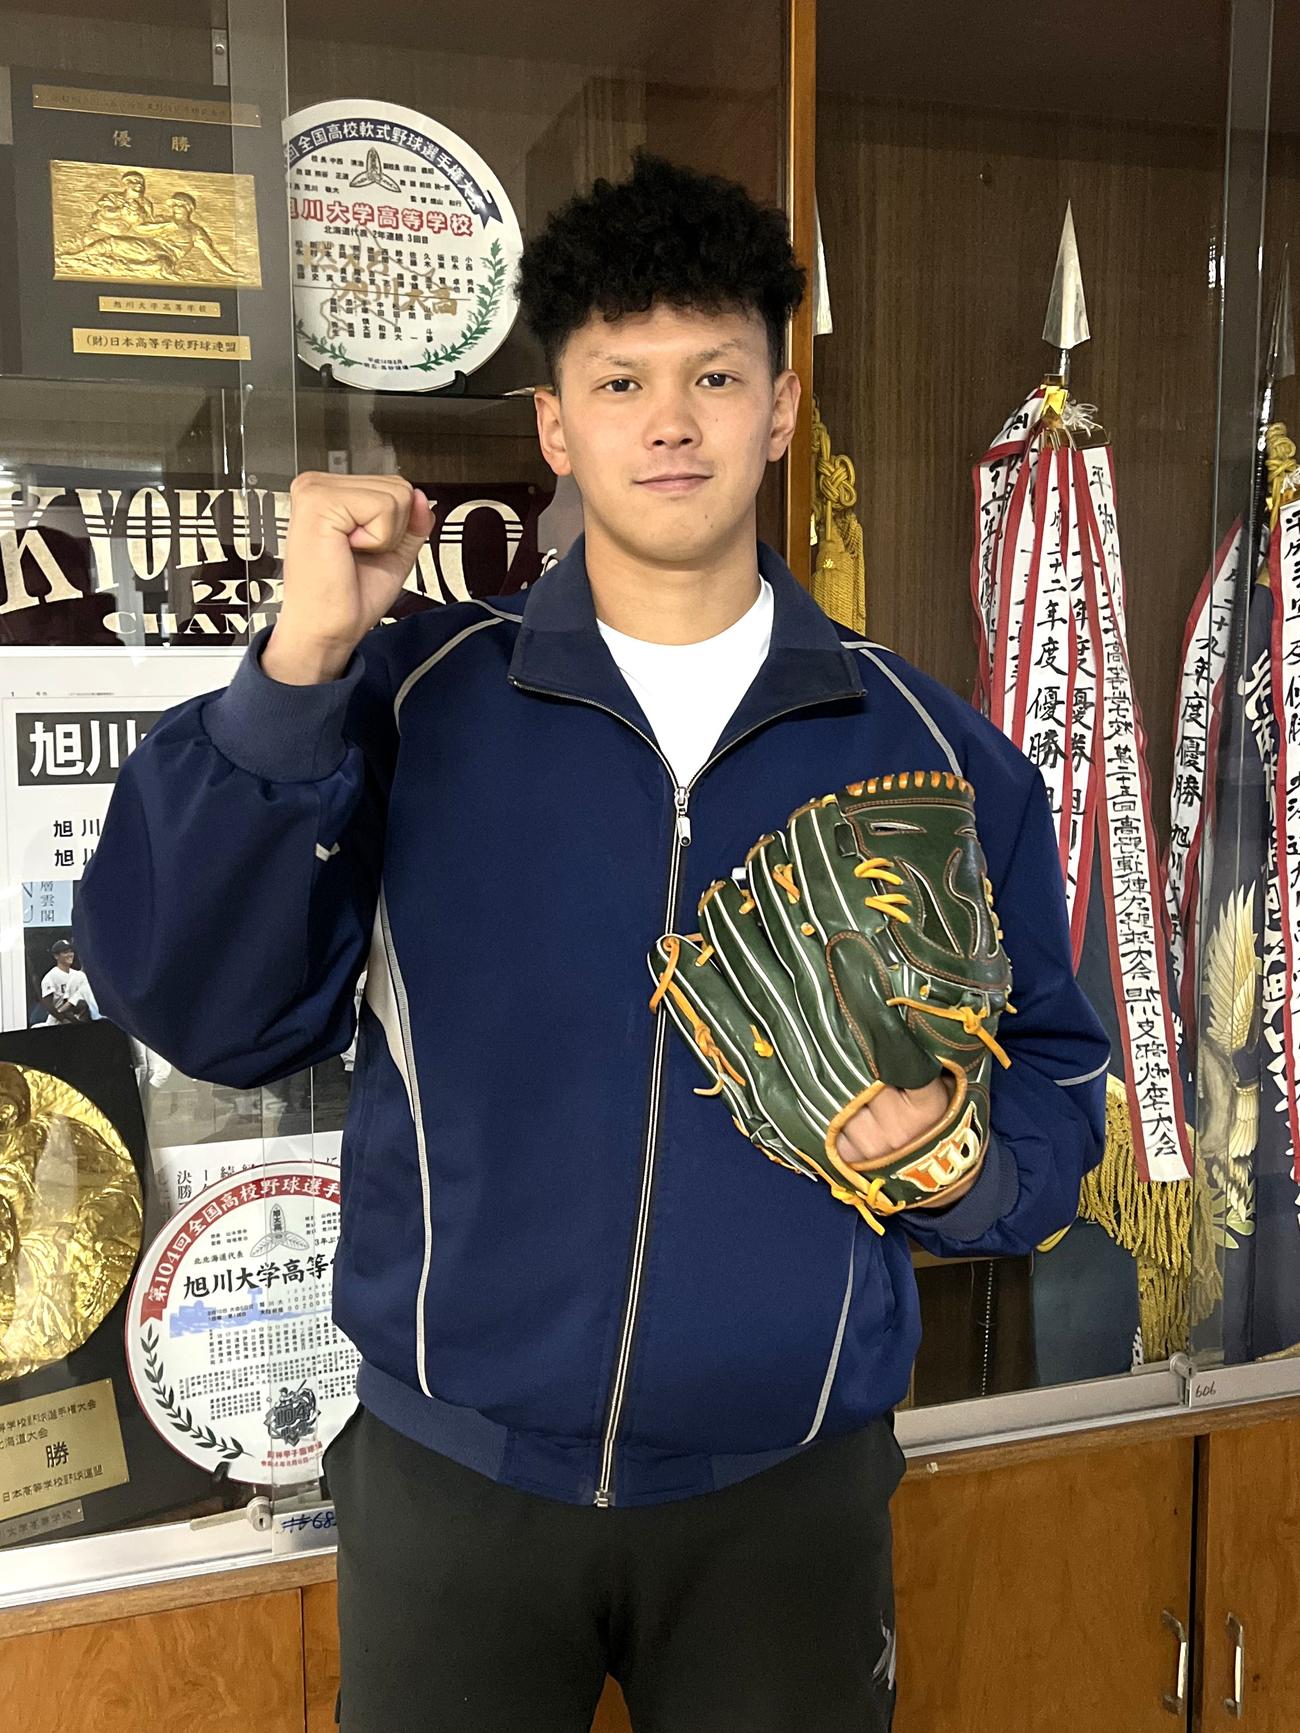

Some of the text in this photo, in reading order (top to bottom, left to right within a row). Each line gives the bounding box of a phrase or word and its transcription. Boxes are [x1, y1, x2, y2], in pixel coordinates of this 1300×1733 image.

[192, 579, 284, 604] 20
[102, 612, 282, 636] CHAM
[29, 719, 148, 778] 旭川
[53, 819, 100, 838] 旭川
[183, 1253, 335, 1300] 旭川大学高等
[1195, 1381, 1217, 1397] 606
[46, 1441, 69, 1469] 勝
[281, 1511, 336, 1533] #68
